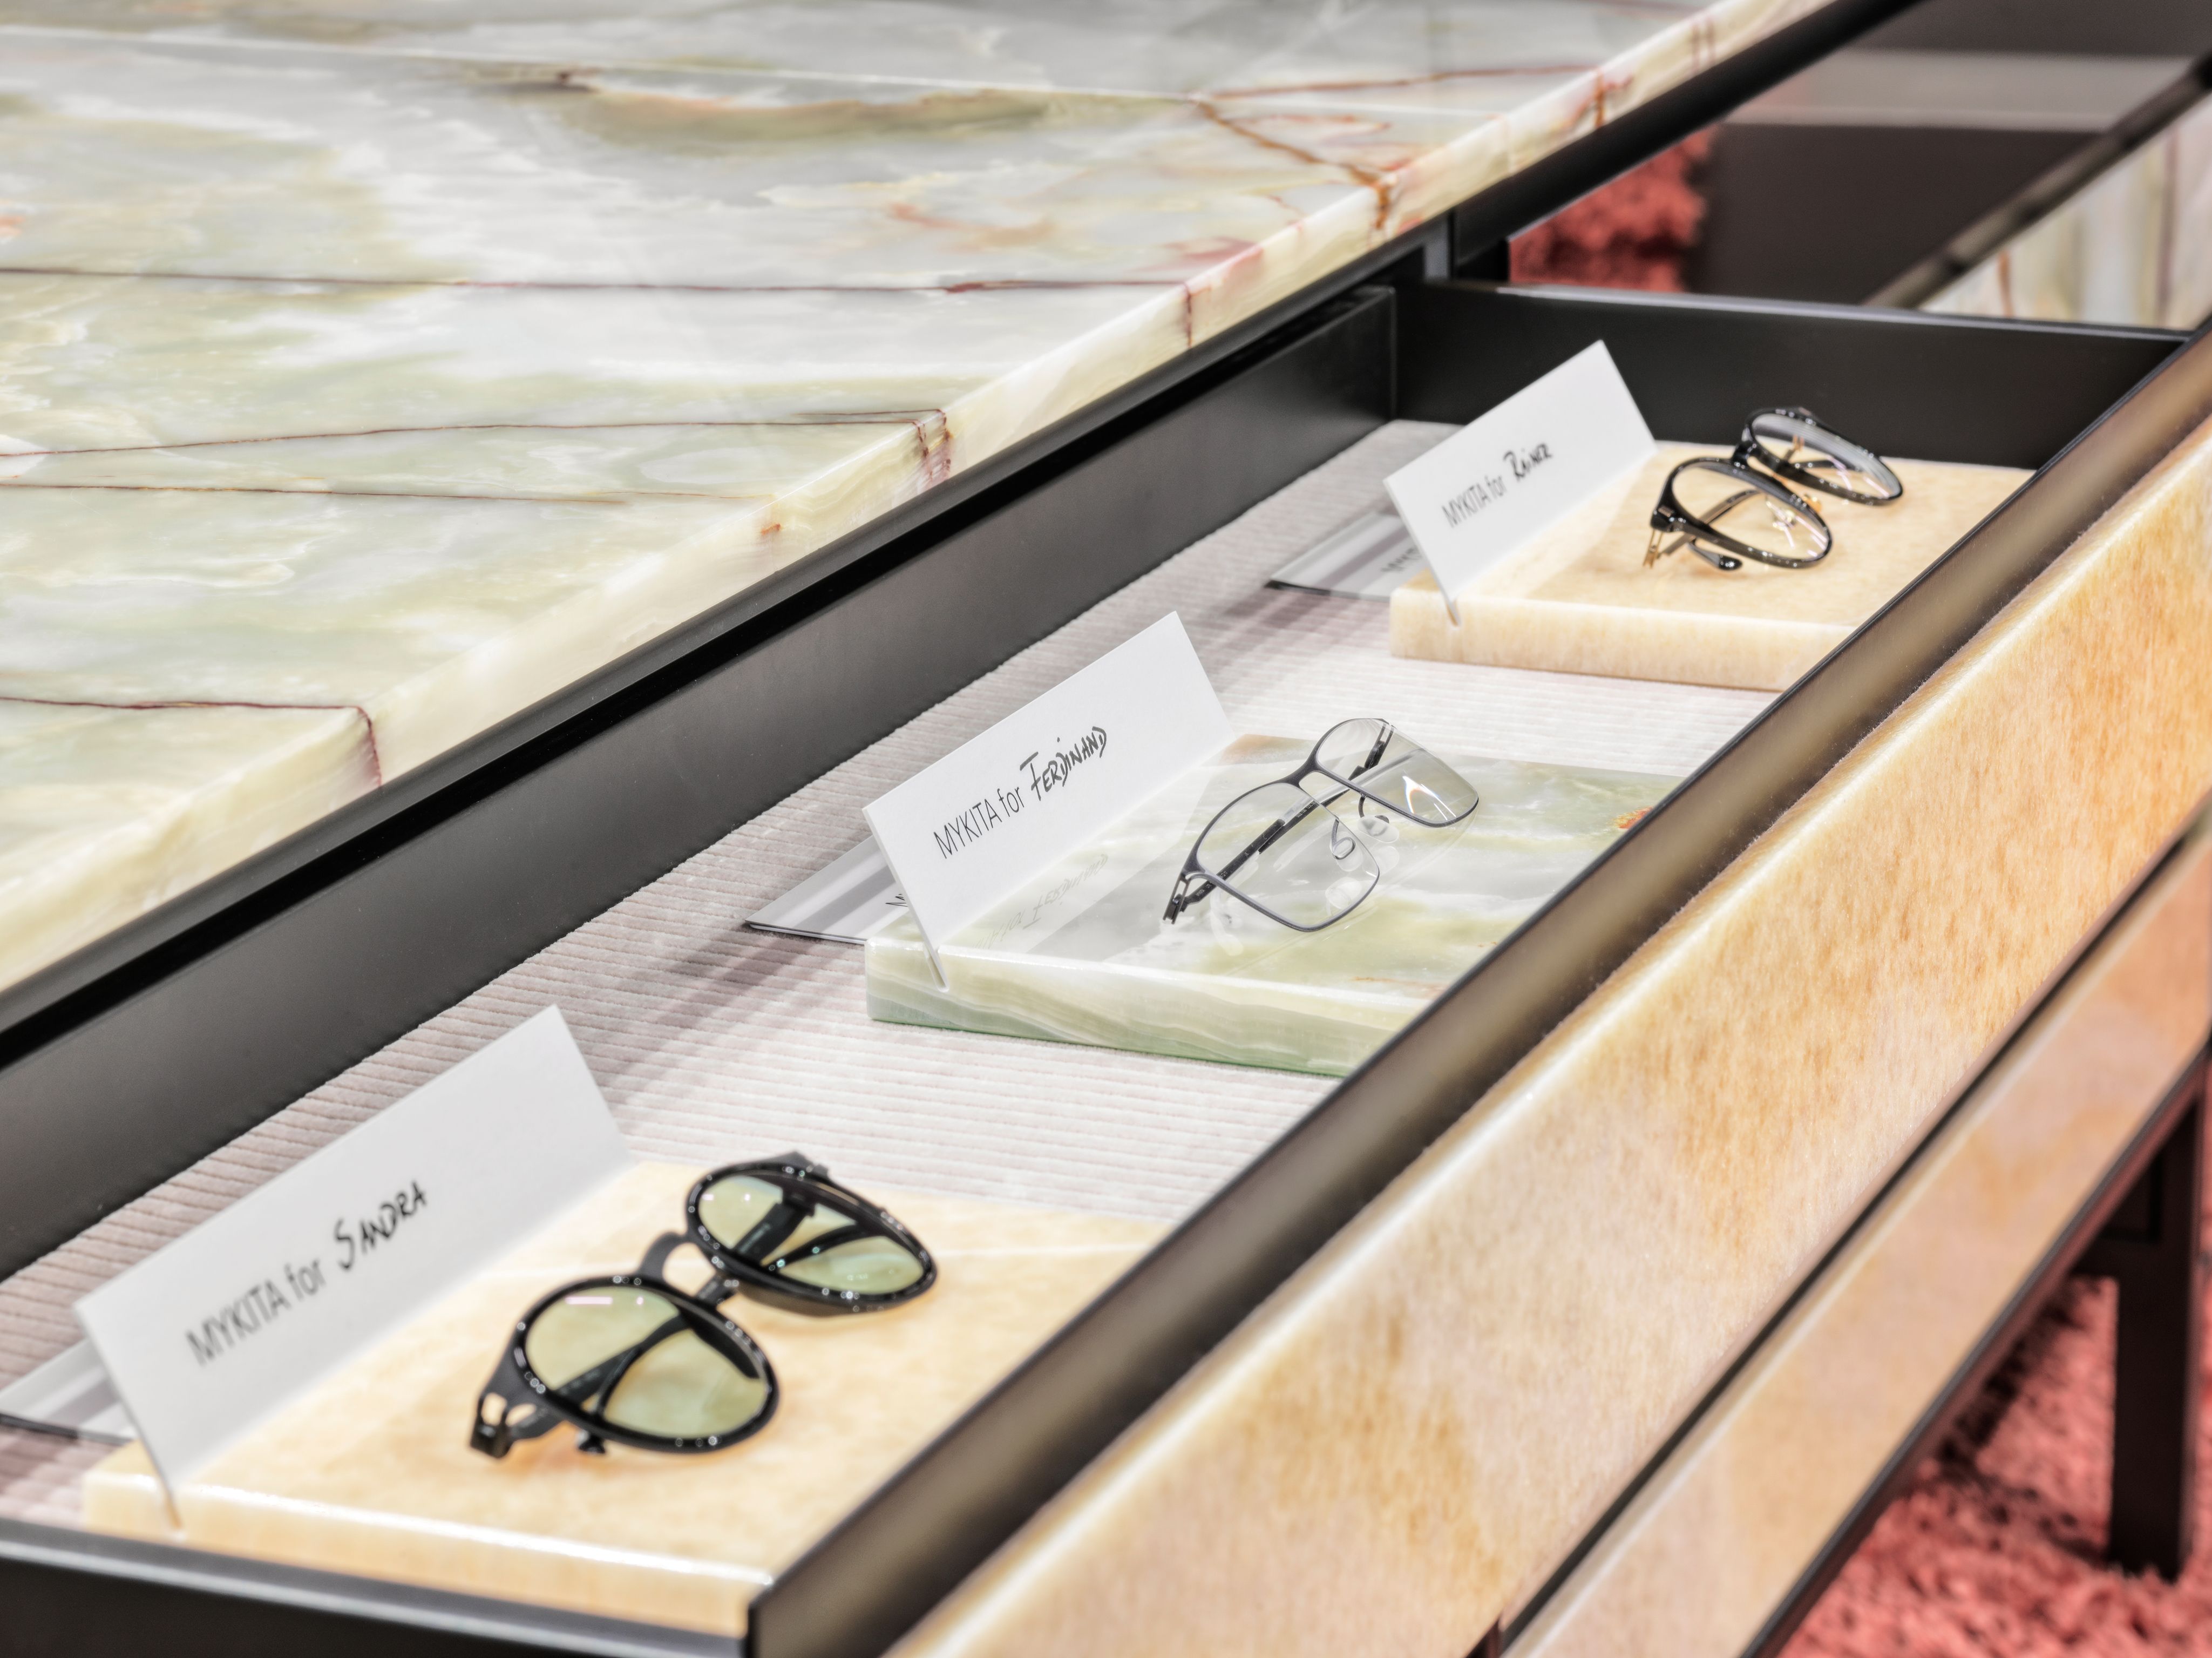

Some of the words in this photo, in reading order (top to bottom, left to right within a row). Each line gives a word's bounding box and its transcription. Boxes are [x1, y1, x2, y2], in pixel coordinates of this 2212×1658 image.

[1441, 483, 1492, 529] MYKITA
[1484, 475, 1507, 499] for
[933, 798, 1002, 859] MYKITA
[997, 788, 1024, 817] for
[1020, 726, 1107, 801] FERDINAND
[185, 1279, 292, 1366] MYKITA
[284, 1260, 326, 1301] for
[333, 1180, 427, 1270] SANDRA
